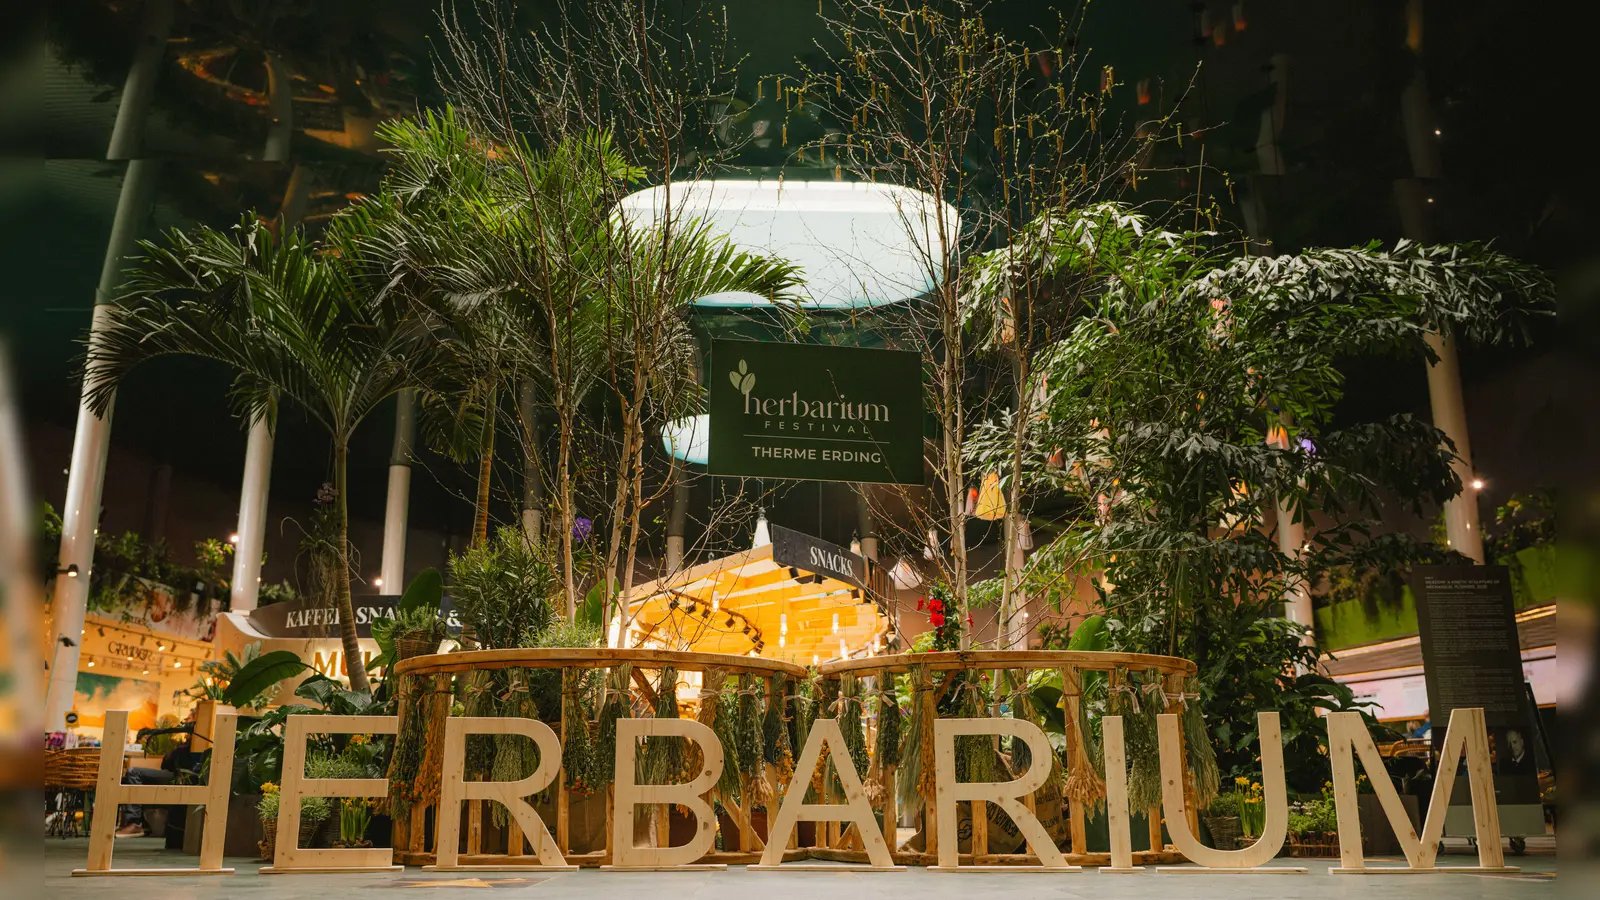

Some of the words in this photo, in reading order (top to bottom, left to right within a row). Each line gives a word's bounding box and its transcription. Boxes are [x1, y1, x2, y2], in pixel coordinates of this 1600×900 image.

[744, 390, 890, 422] herbarium
[764, 420, 869, 435] FESTIVAL
[752, 446, 817, 460] THERME
[822, 450, 881, 463] ERDING
[810, 546, 853, 577] SNACKS
[87, 708, 1505, 872] HERBARIUM
